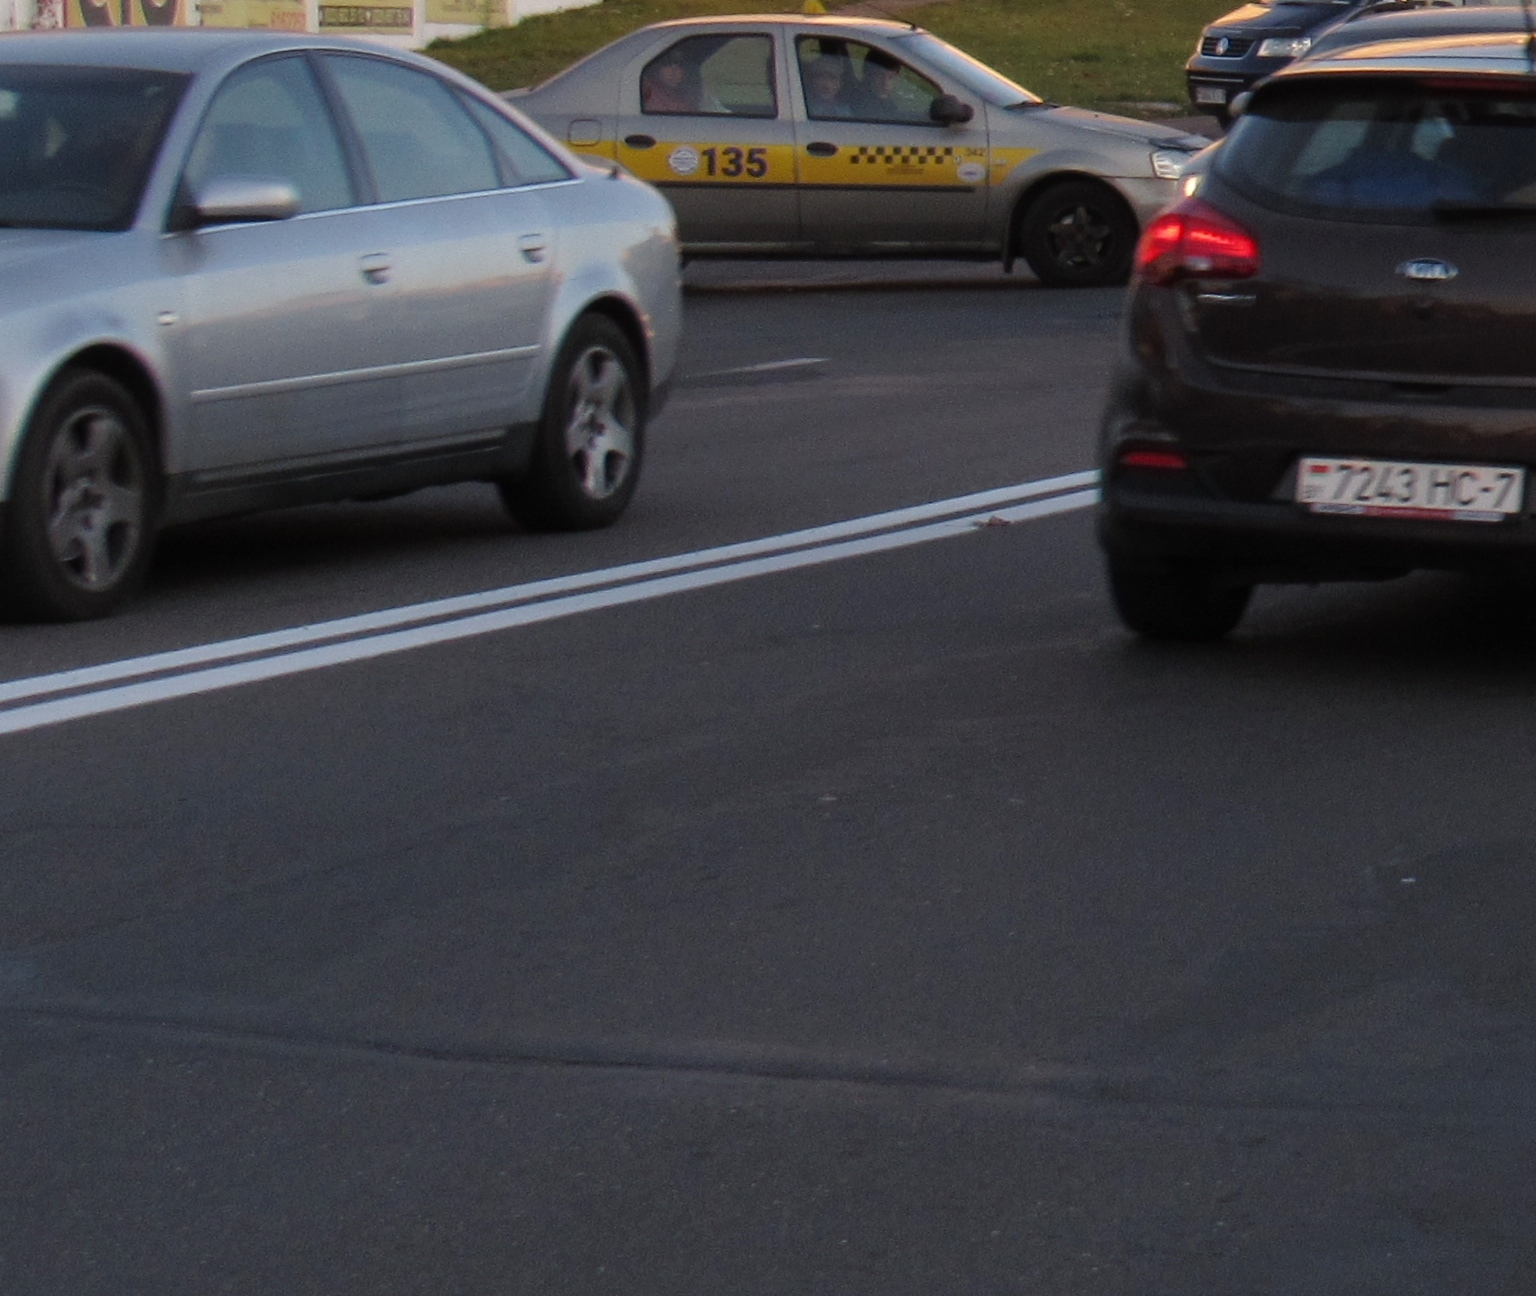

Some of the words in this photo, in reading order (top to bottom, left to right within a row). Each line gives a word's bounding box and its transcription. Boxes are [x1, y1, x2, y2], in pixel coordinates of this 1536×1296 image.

[702, 147, 768, 178] 135
[1333, 463, 1420, 503] 7243
[1429, 469, 1516, 508] HC-7
